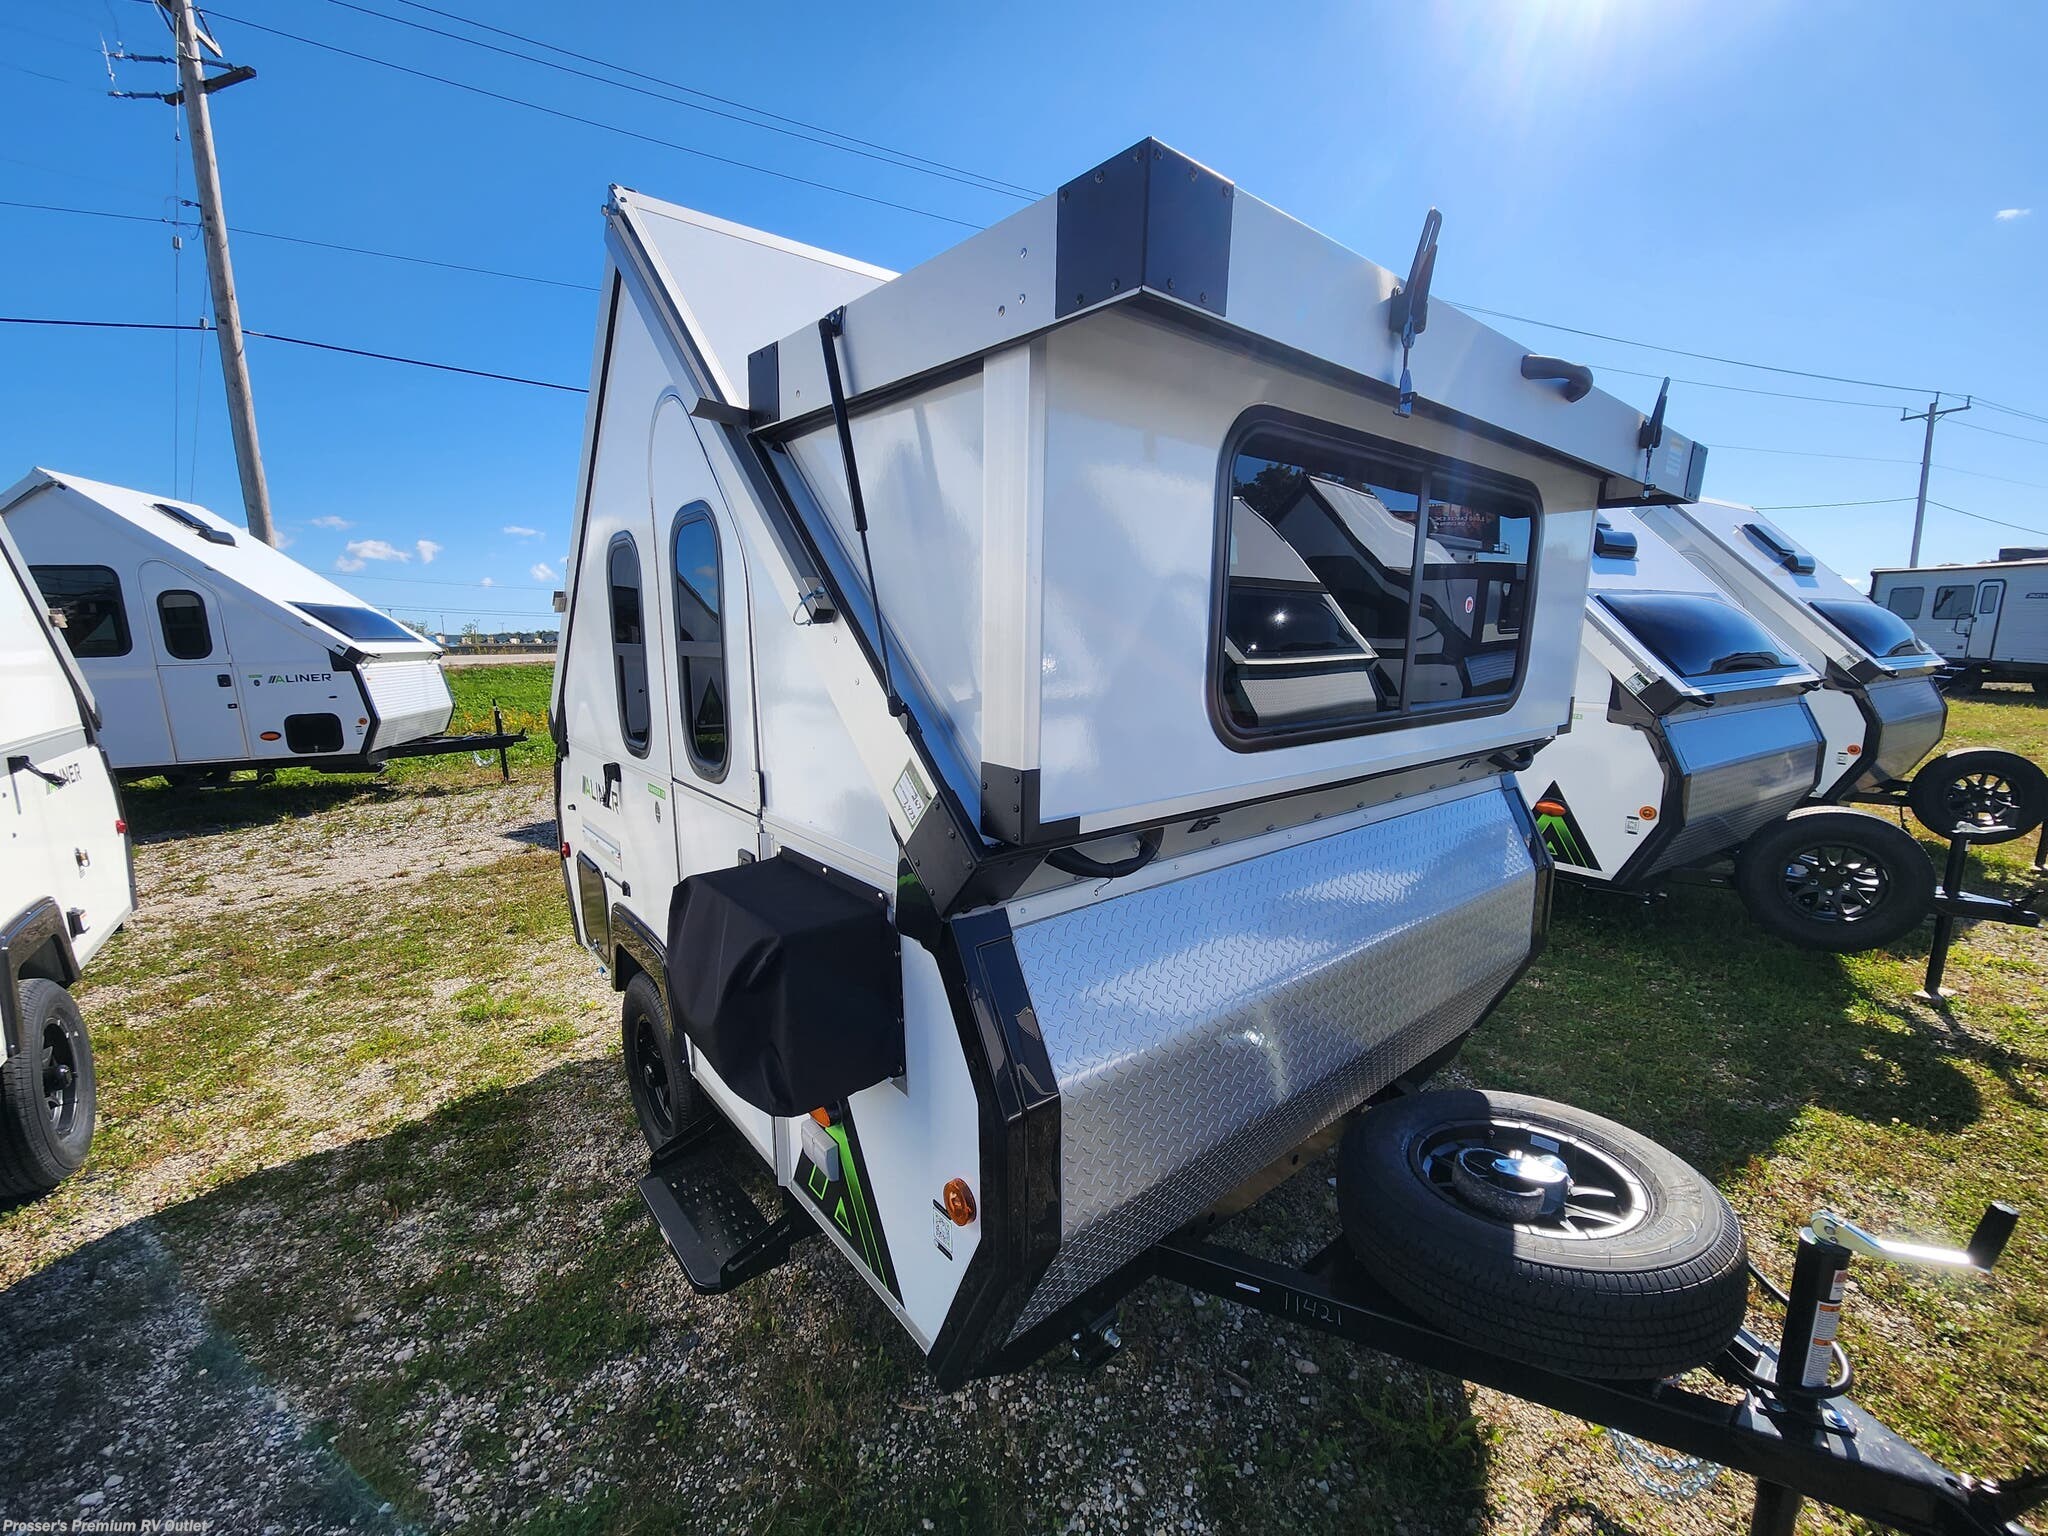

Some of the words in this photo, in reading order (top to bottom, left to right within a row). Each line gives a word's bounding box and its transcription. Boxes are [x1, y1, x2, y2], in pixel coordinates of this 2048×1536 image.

[268, 673, 332, 684] ALINER
[583, 775, 620, 815] ALINR
[1284, 1291, 1342, 1326] 11421
